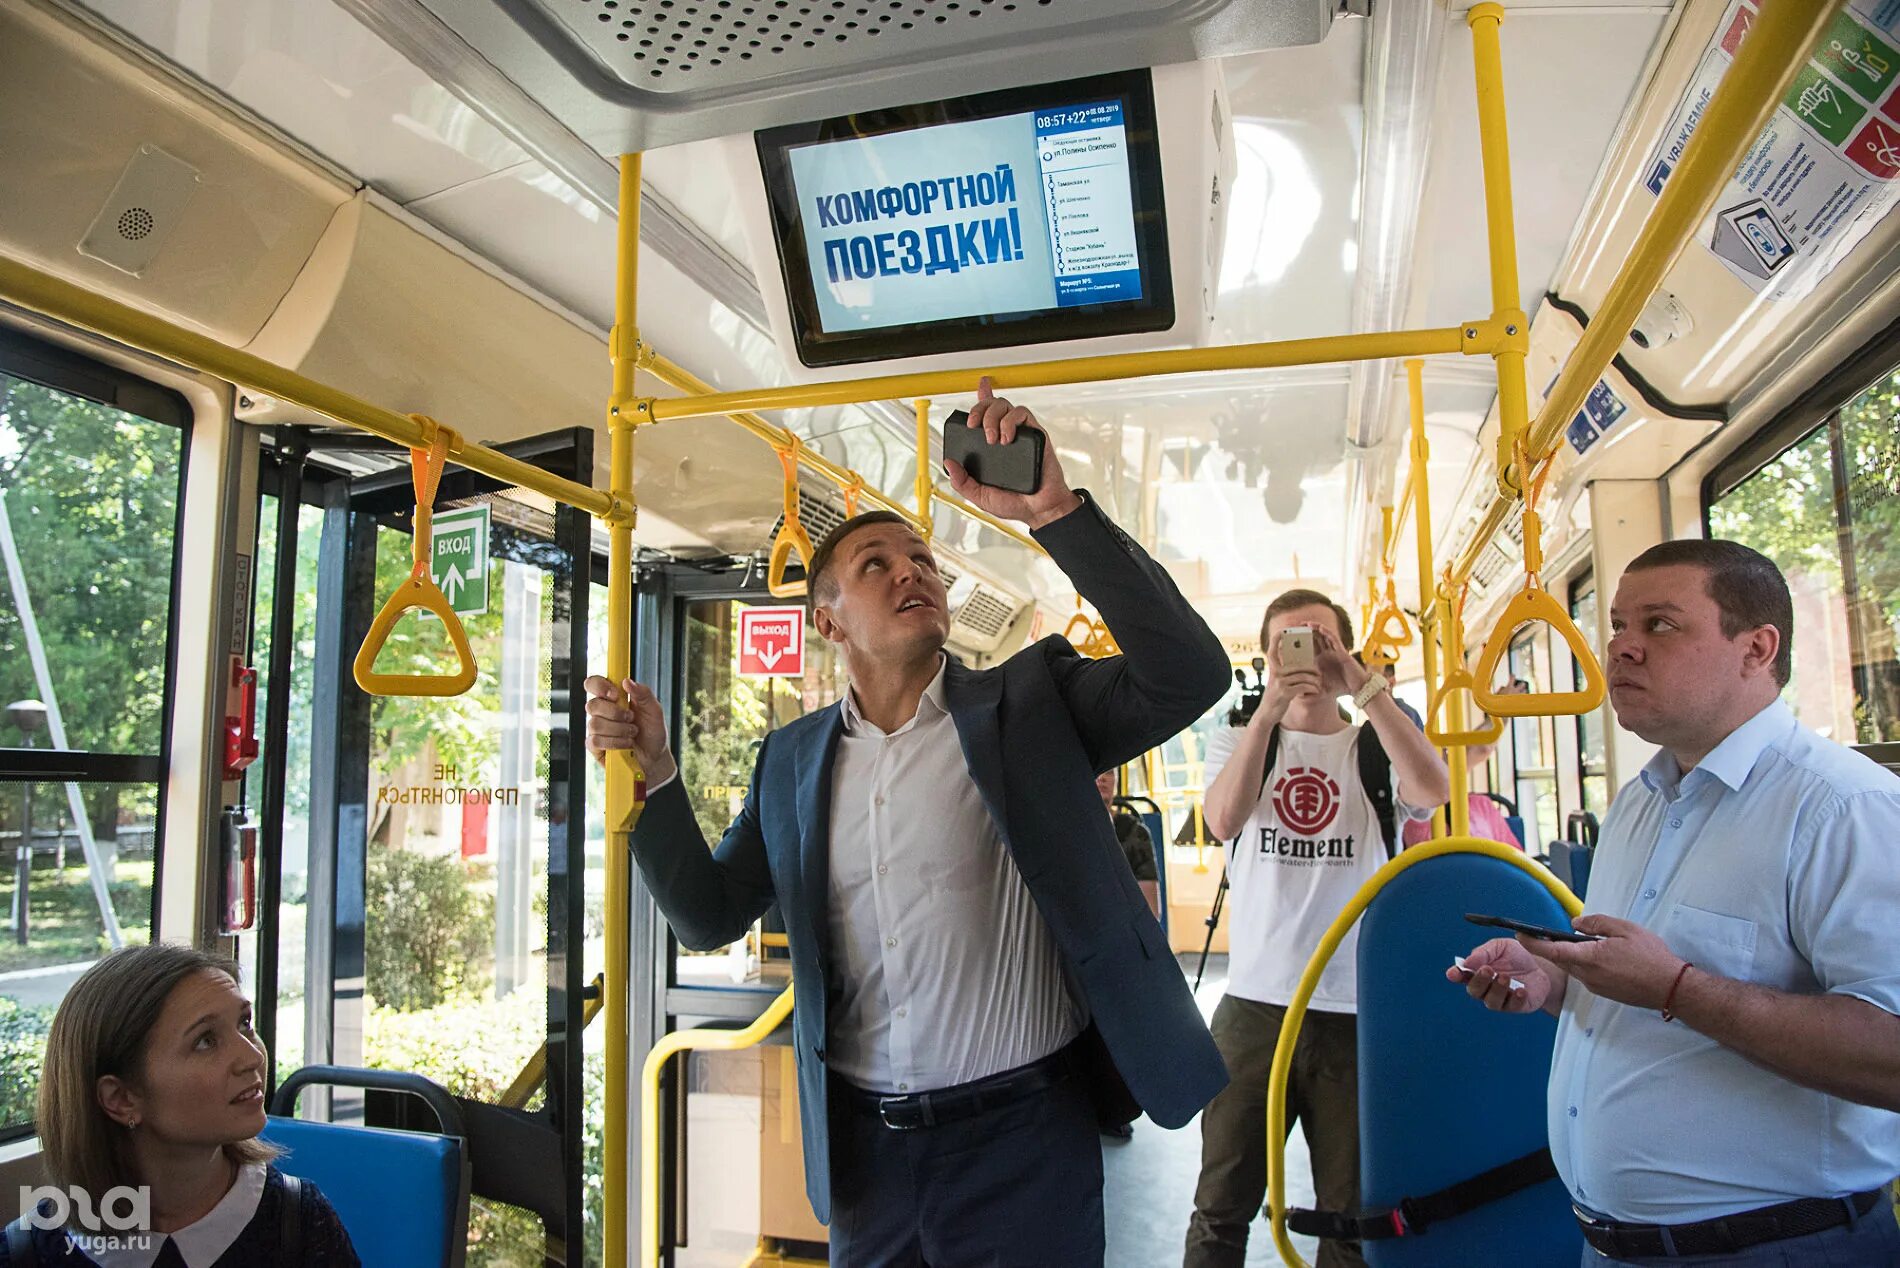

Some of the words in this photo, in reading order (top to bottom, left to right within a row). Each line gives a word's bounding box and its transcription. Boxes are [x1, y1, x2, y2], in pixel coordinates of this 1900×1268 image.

[1088, 142, 1116, 153] Осипенко
[816, 163, 1016, 228] КОМФОРТНОЙ
[824, 208, 1025, 283] ПОЕЗДКИ!
[438, 536, 471, 555] ВХОД
[236, 560, 247, 601] СТОП
[233, 609, 243, 649] КРАН
[752, 625, 790, 636] ВЫХОД
[1260, 828, 1354, 858] Element
